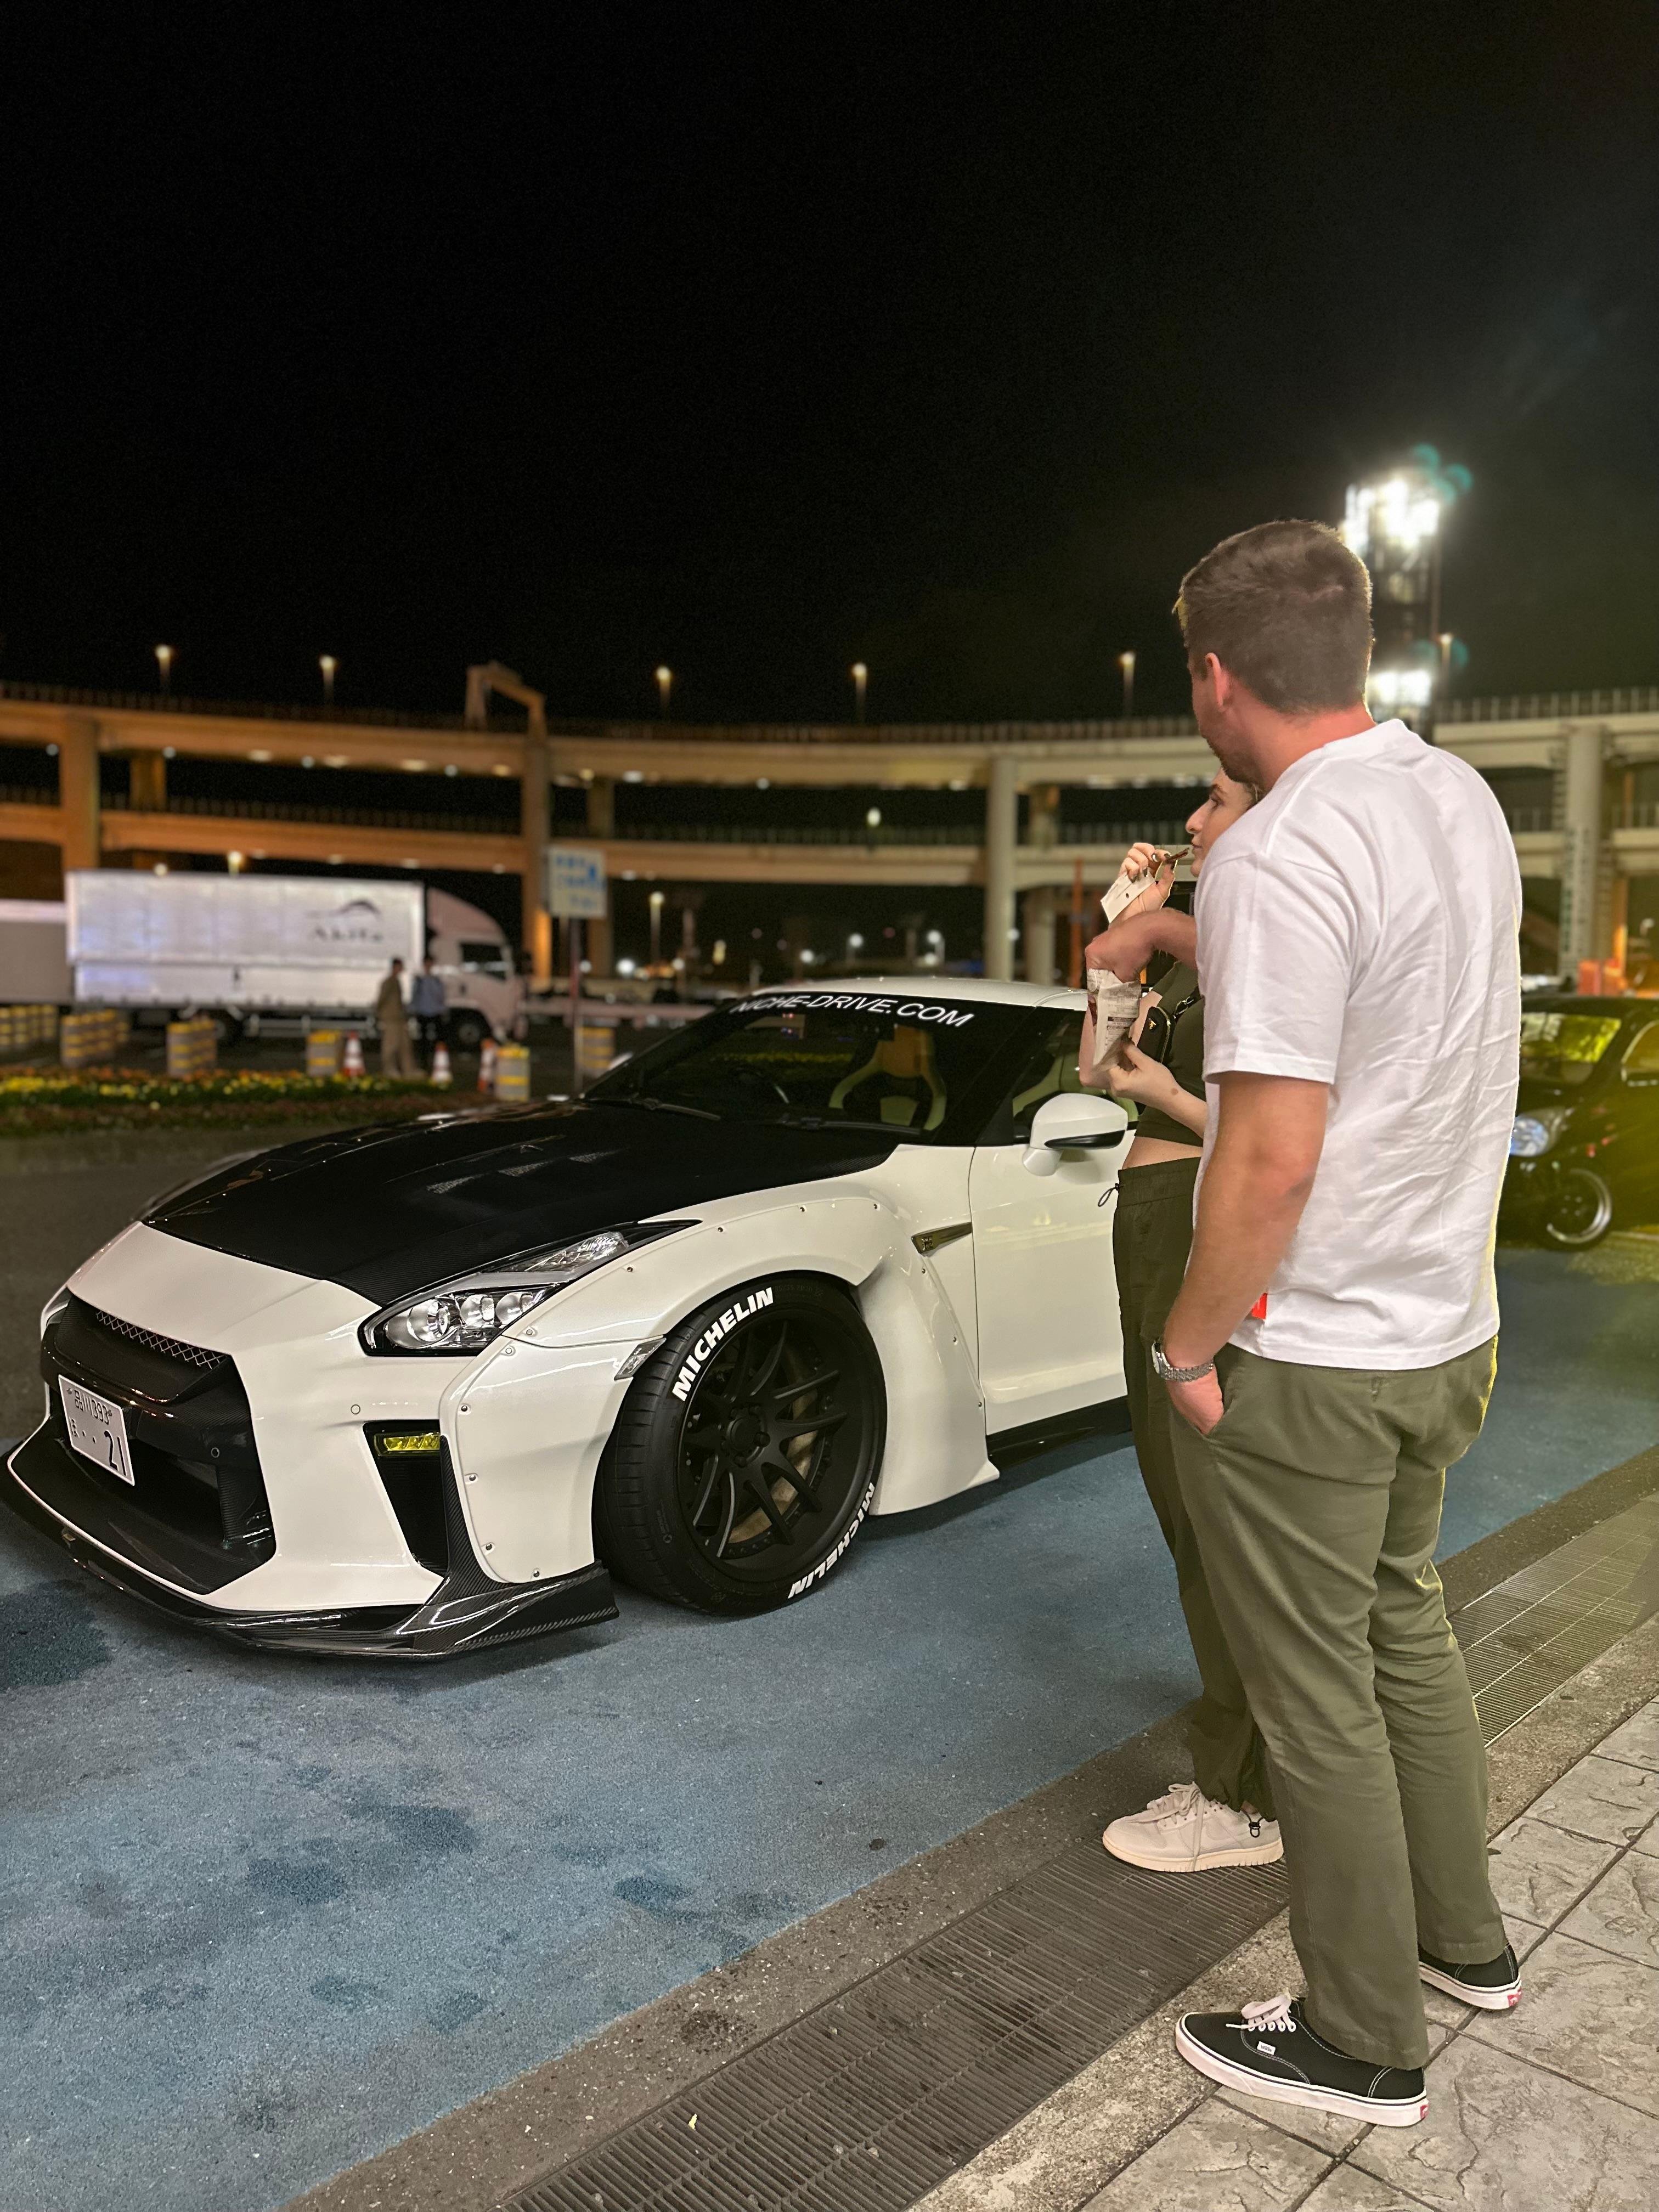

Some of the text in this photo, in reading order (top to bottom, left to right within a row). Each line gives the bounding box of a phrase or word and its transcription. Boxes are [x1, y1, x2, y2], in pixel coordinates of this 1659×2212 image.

[729, 996, 975, 1026] NICHE-DRIVE.COM
[672, 1287, 774, 1402] MICHELIN
[788, 1482, 875, 1599] MICHELIN
